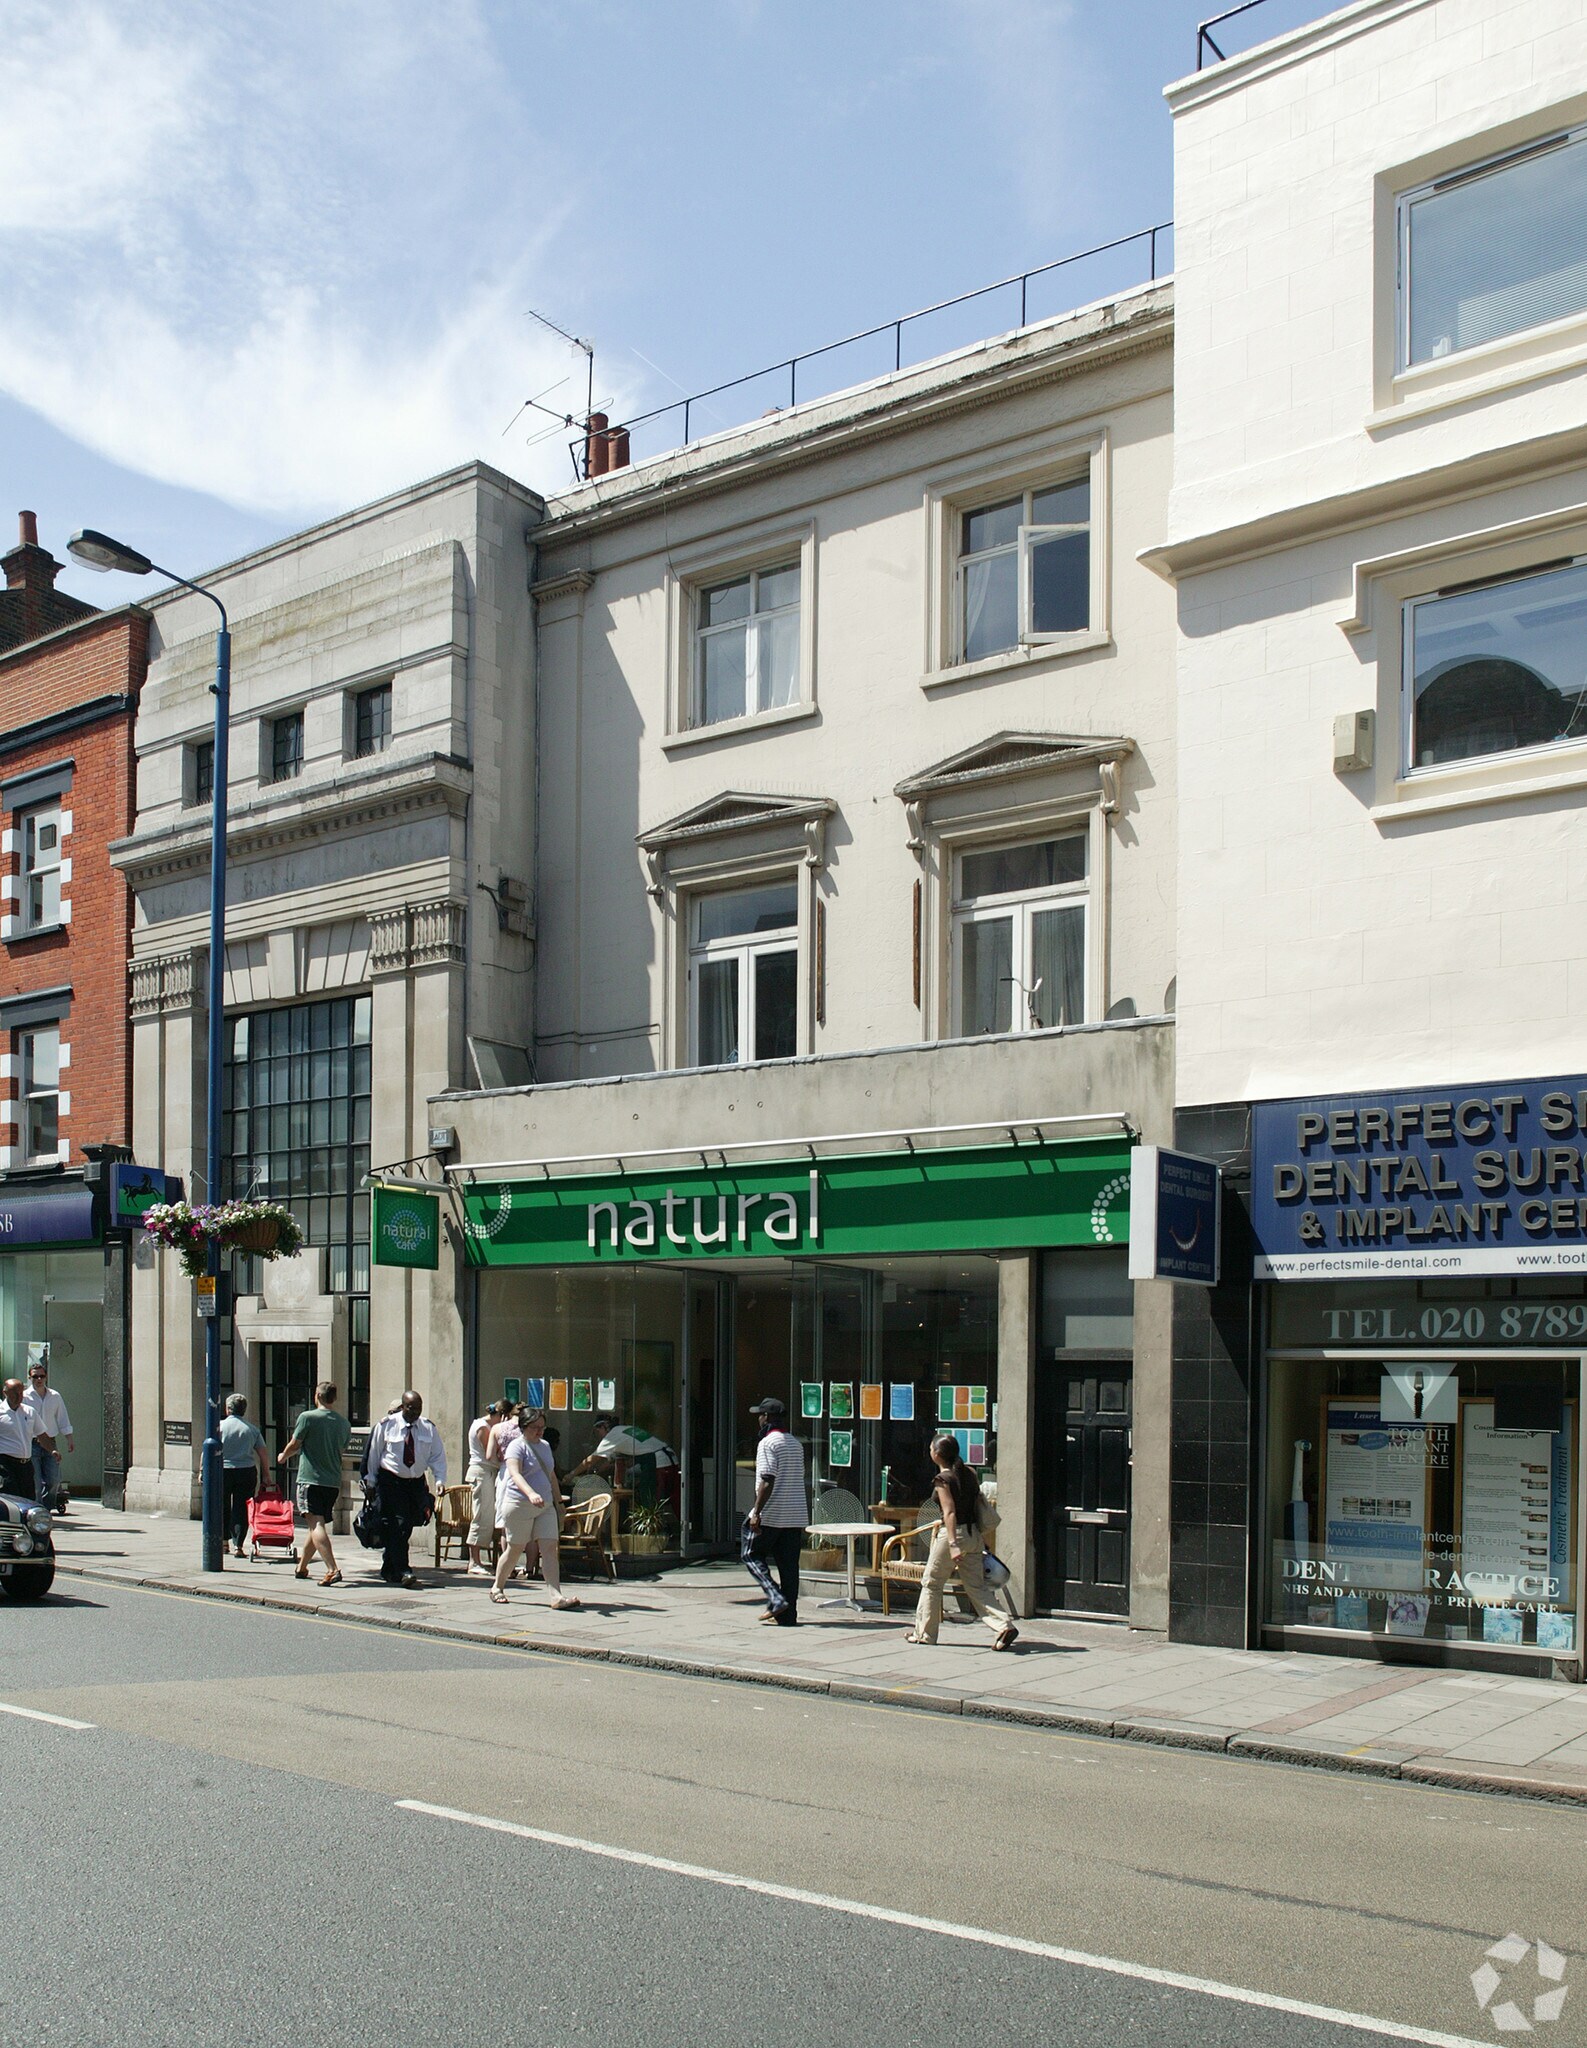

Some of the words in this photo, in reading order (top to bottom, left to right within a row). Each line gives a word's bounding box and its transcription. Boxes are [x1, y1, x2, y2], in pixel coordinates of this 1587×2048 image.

[1297, 1096, 1524, 1148] PERFECT
[1540, 1088, 1587, 1131] S
[1273, 1154, 1459, 1199] DENTAL
[1471, 1147, 1587, 1188] SUR
[588, 1170, 818, 1247] natural
[1298, 1211, 1322, 1240] &
[1336, 1202, 1508, 1237] IMPLANT
[383, 1224, 430, 1240] natural
[1265, 1256, 1462, 1273] www.perfectsmile-dental.com
[1516, 1251, 1587, 1266] www.toot
[1388, 1428, 1449, 1441] TOOTH
[1388, 1442, 1449, 1453] IMPLANT
[1487, 1432, 1528, 1440] Information
[1387, 1453, 1449, 1465] CENTRE
[1554, 1446, 1568, 1505] Treatment
[1554, 1510, 1568, 1565] Cosmetic
[1422, 1568, 1561, 1598] RACTICE
[1282, 1583, 1310, 1596] NHS
[1313, 1586, 1344, 1598] AND
[1515, 1601, 1559, 1614] CARE
